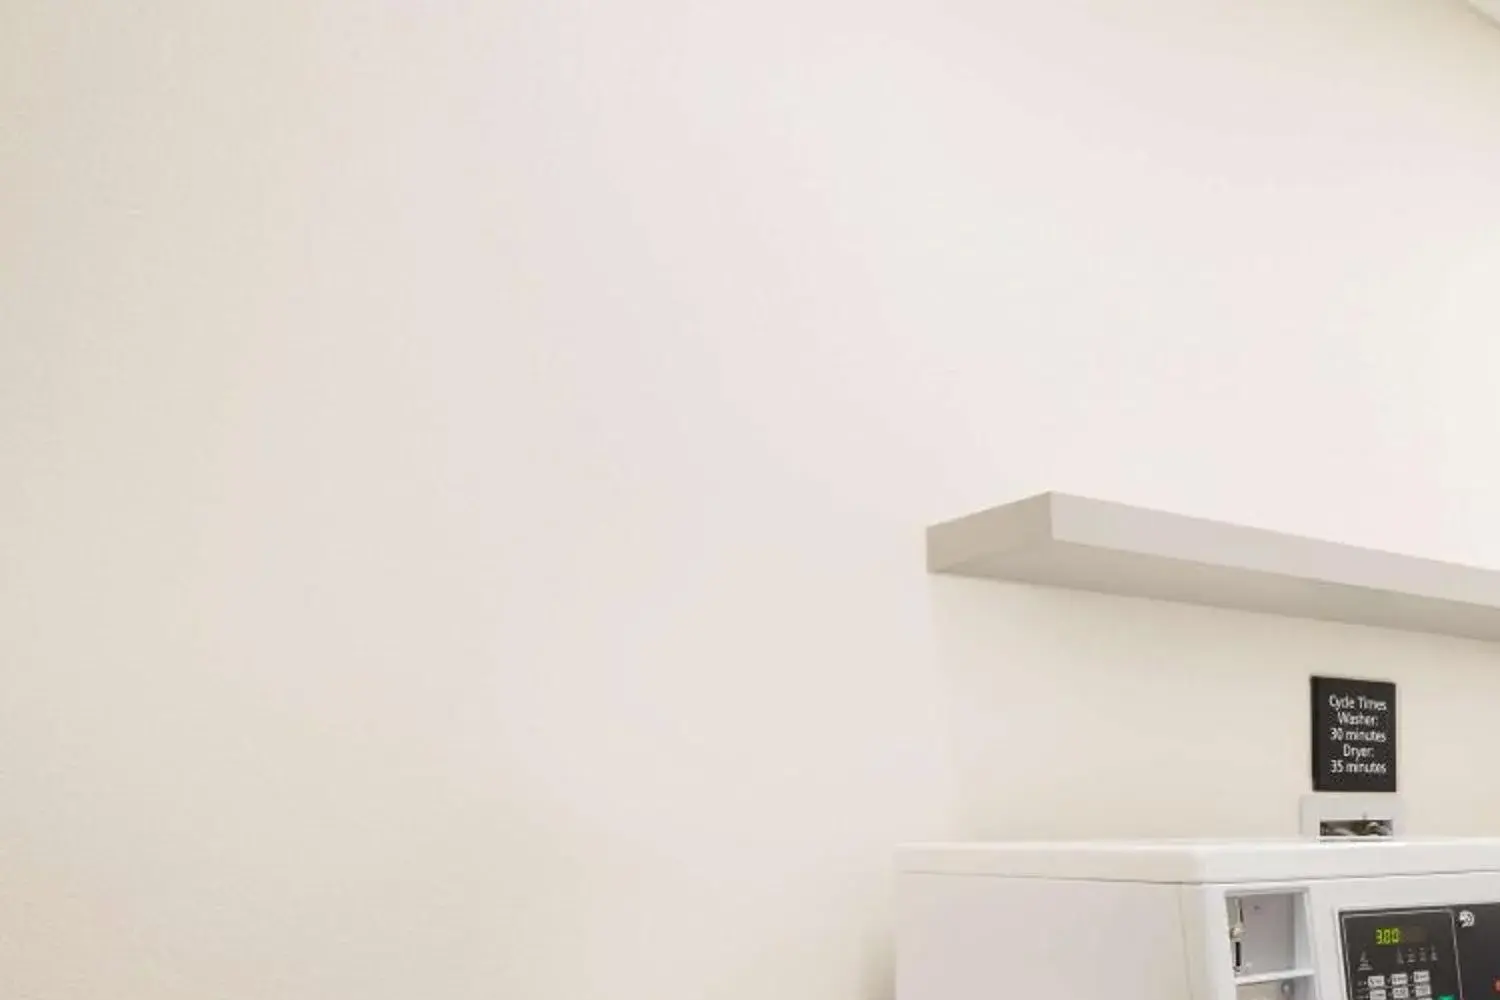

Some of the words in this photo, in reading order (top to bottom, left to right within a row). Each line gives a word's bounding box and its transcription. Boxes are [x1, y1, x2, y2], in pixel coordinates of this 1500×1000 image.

[1358, 695, 1387, 711] Times
[1330, 727, 1343, 741] 30
[1346, 728, 1386, 742] minutes
[1330, 759, 1343, 773] 35
[1346, 761, 1386, 773] minutes
